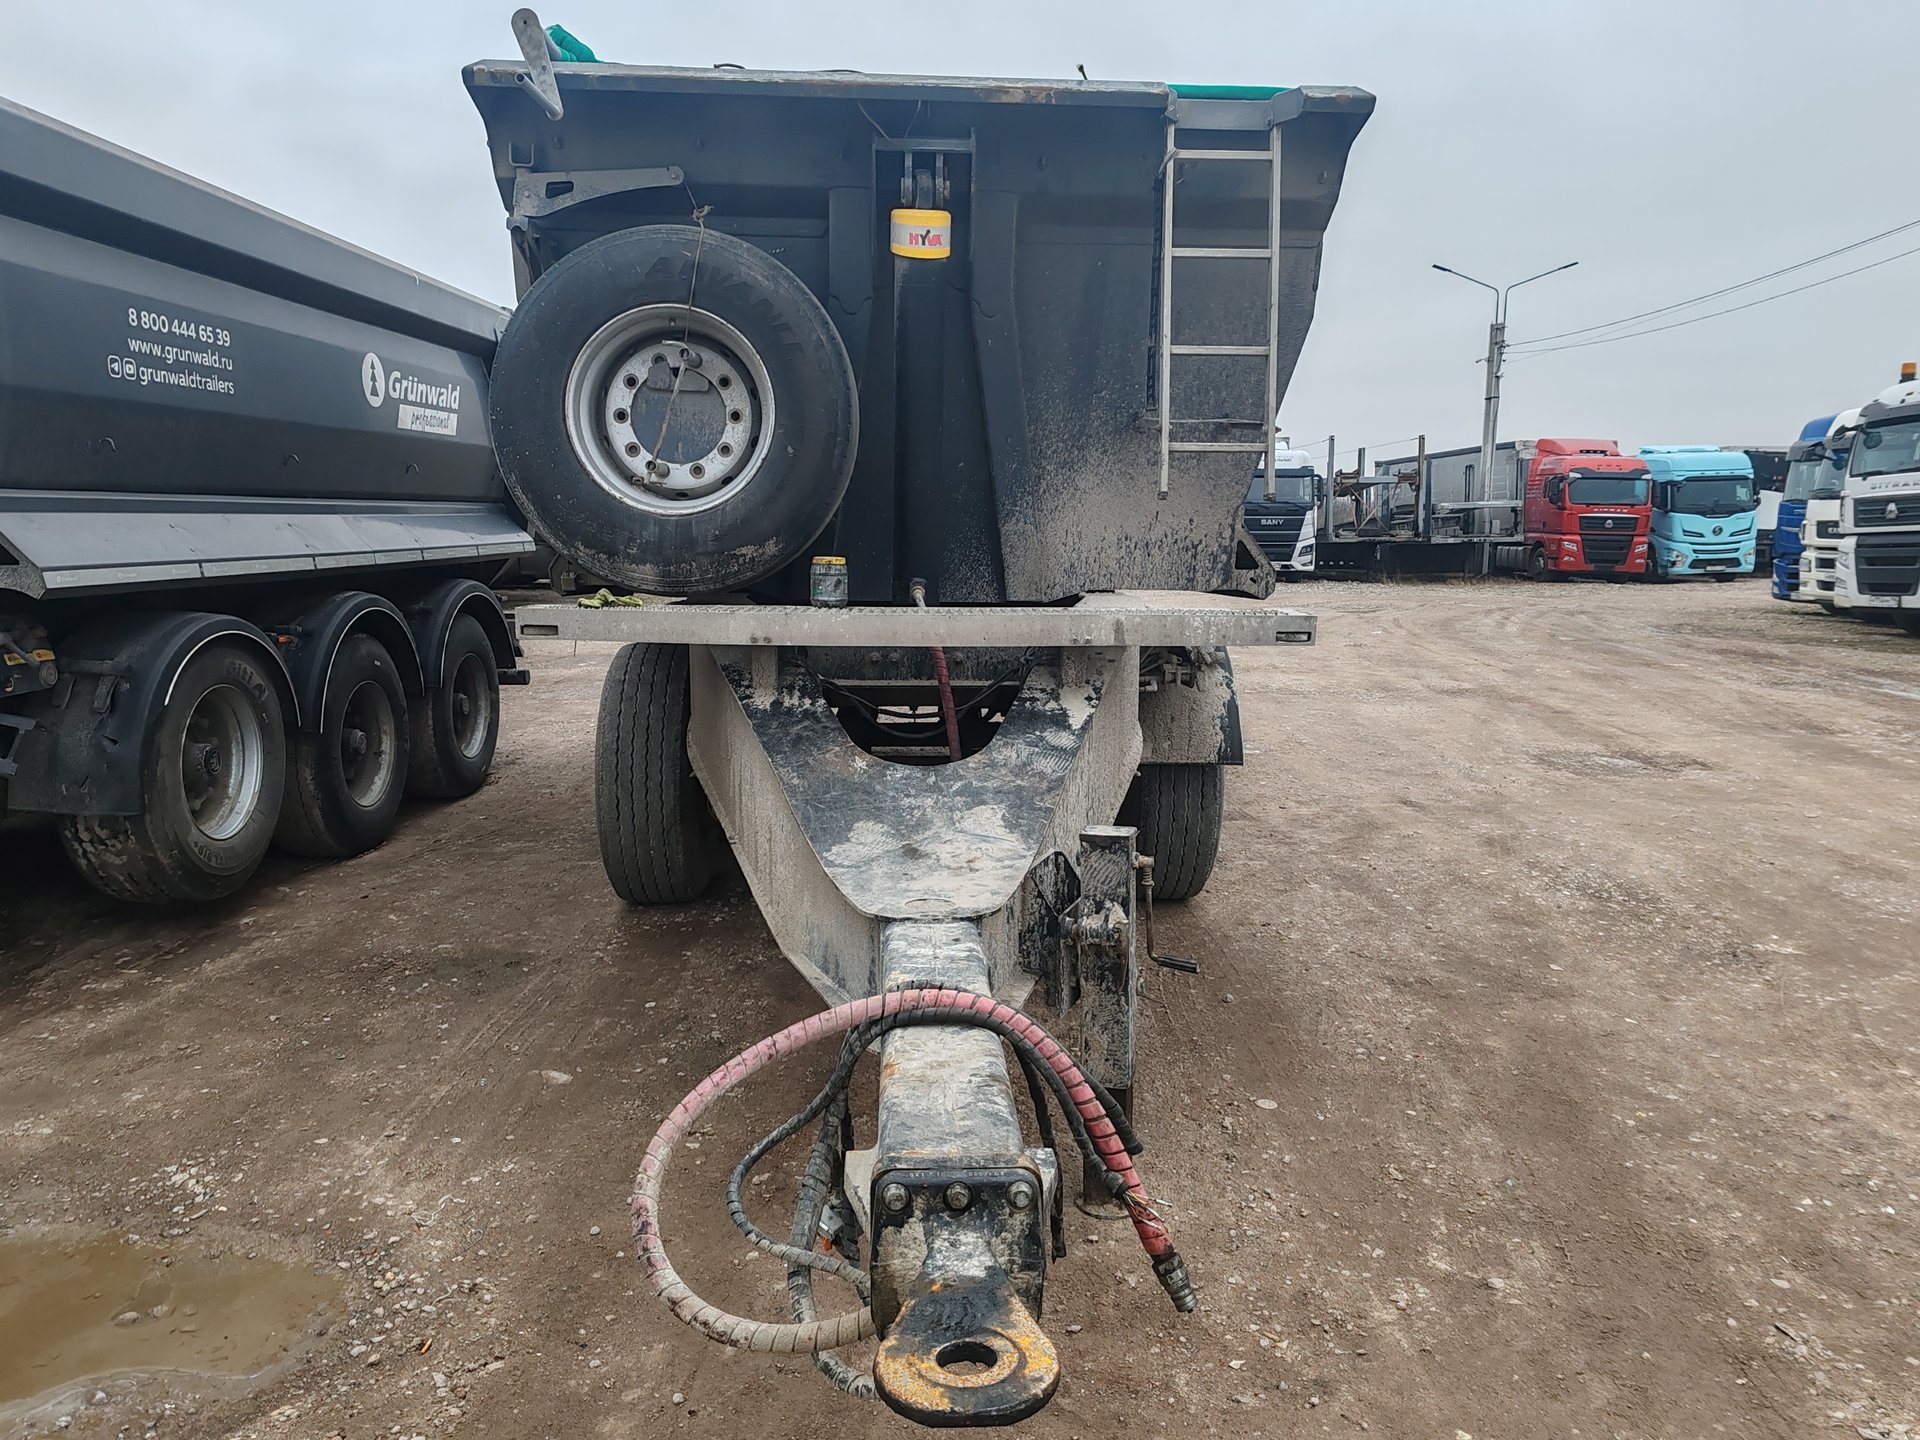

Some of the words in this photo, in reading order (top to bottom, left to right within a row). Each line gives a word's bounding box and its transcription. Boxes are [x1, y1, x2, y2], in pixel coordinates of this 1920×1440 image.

[128, 308, 138, 326] 8
[141, 311, 169, 333] 800
[172, 319, 196, 339] 444
[199, 325, 214, 344] 65
[216, 329, 231, 347] 39
[128, 338, 233, 371] www.grunwald.ru
[139, 366, 235, 394] grunwaldtrailers
[388, 370, 460, 410] Grünwald
